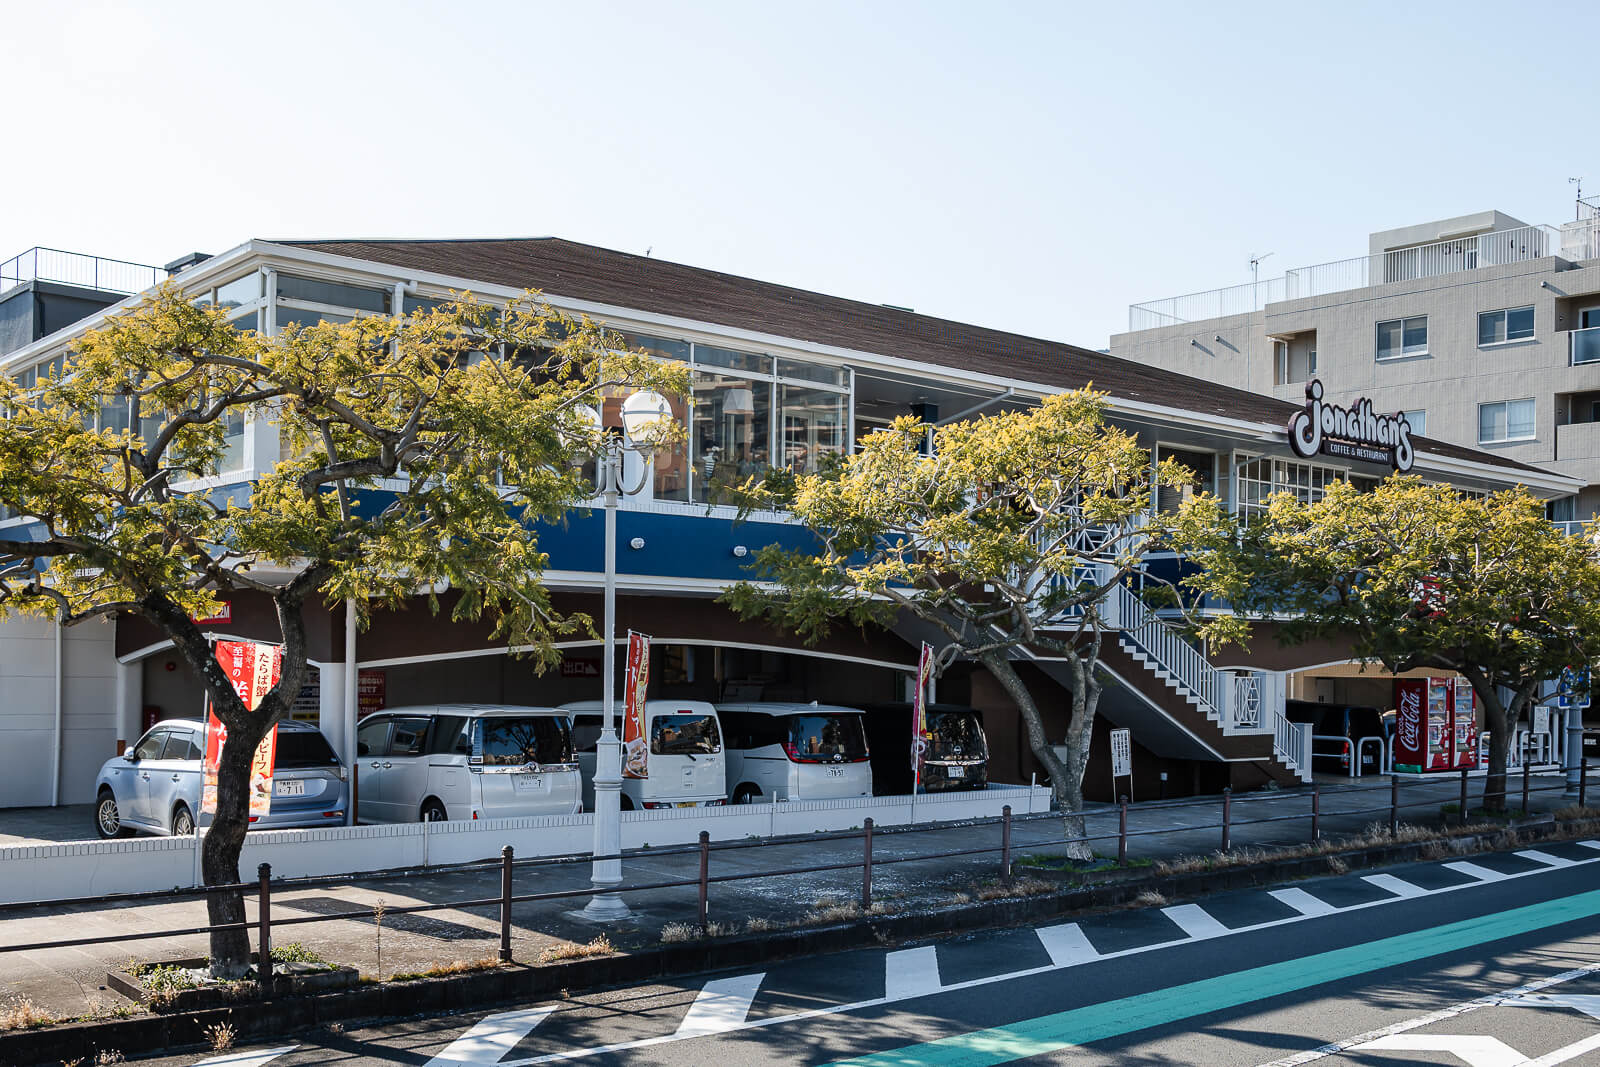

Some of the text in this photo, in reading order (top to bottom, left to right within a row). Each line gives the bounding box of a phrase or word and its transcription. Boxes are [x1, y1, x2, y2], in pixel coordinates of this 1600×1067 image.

[1330, 443, 1350, 455] COFFEE
[563, 661, 585, 674] 出口
[1400, 688, 1420, 752] Coca-Cola
